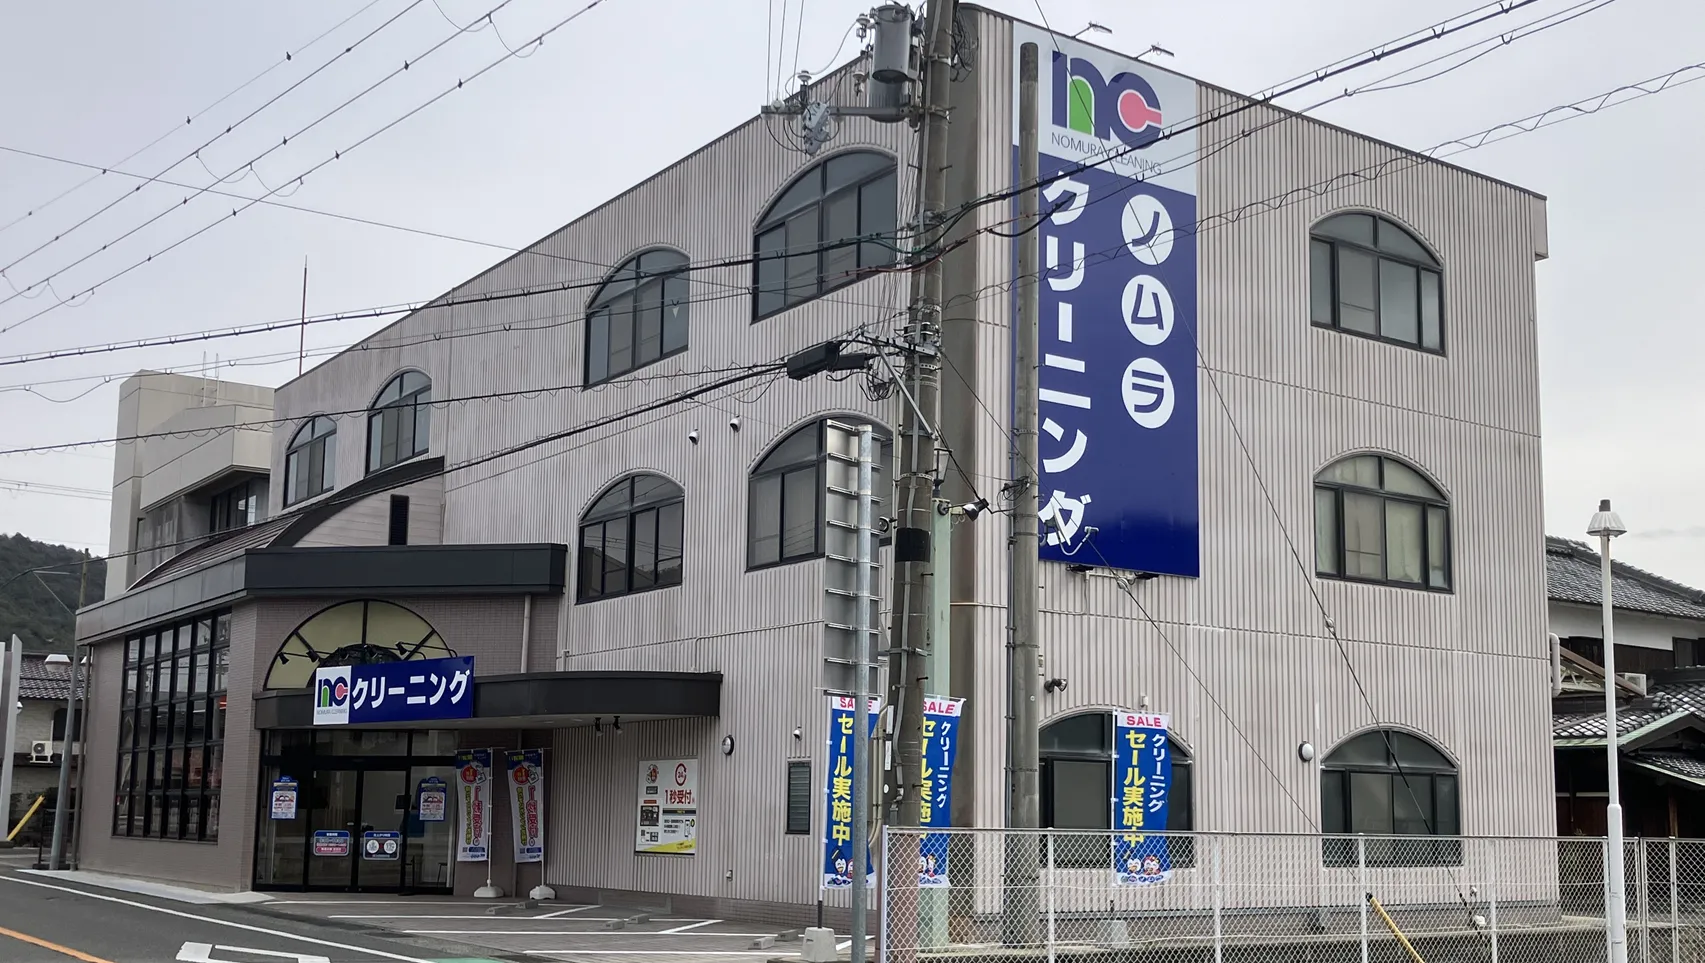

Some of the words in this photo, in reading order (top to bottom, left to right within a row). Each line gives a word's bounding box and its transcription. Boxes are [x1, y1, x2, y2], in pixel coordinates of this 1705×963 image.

[1051, 132, 1105, 158] NOMURA
[1107, 148, 1162, 176] CLEANING
[1128, 206, 1169, 418] ノムラ
[1038, 170, 1092, 547] クリーニング
[352, 669, 470, 710] クリーニング
[840, 696, 873, 711] SAE
[1126, 715, 1162, 727] SALE
[665, 789, 692, 804] 1秒受付
[832, 713, 854, 846] セール実施中
[936, 721, 951, 808] クリーニング
[1122, 730, 1147, 848] セール実施中
[1148, 733, 1166, 813] クリーニング
